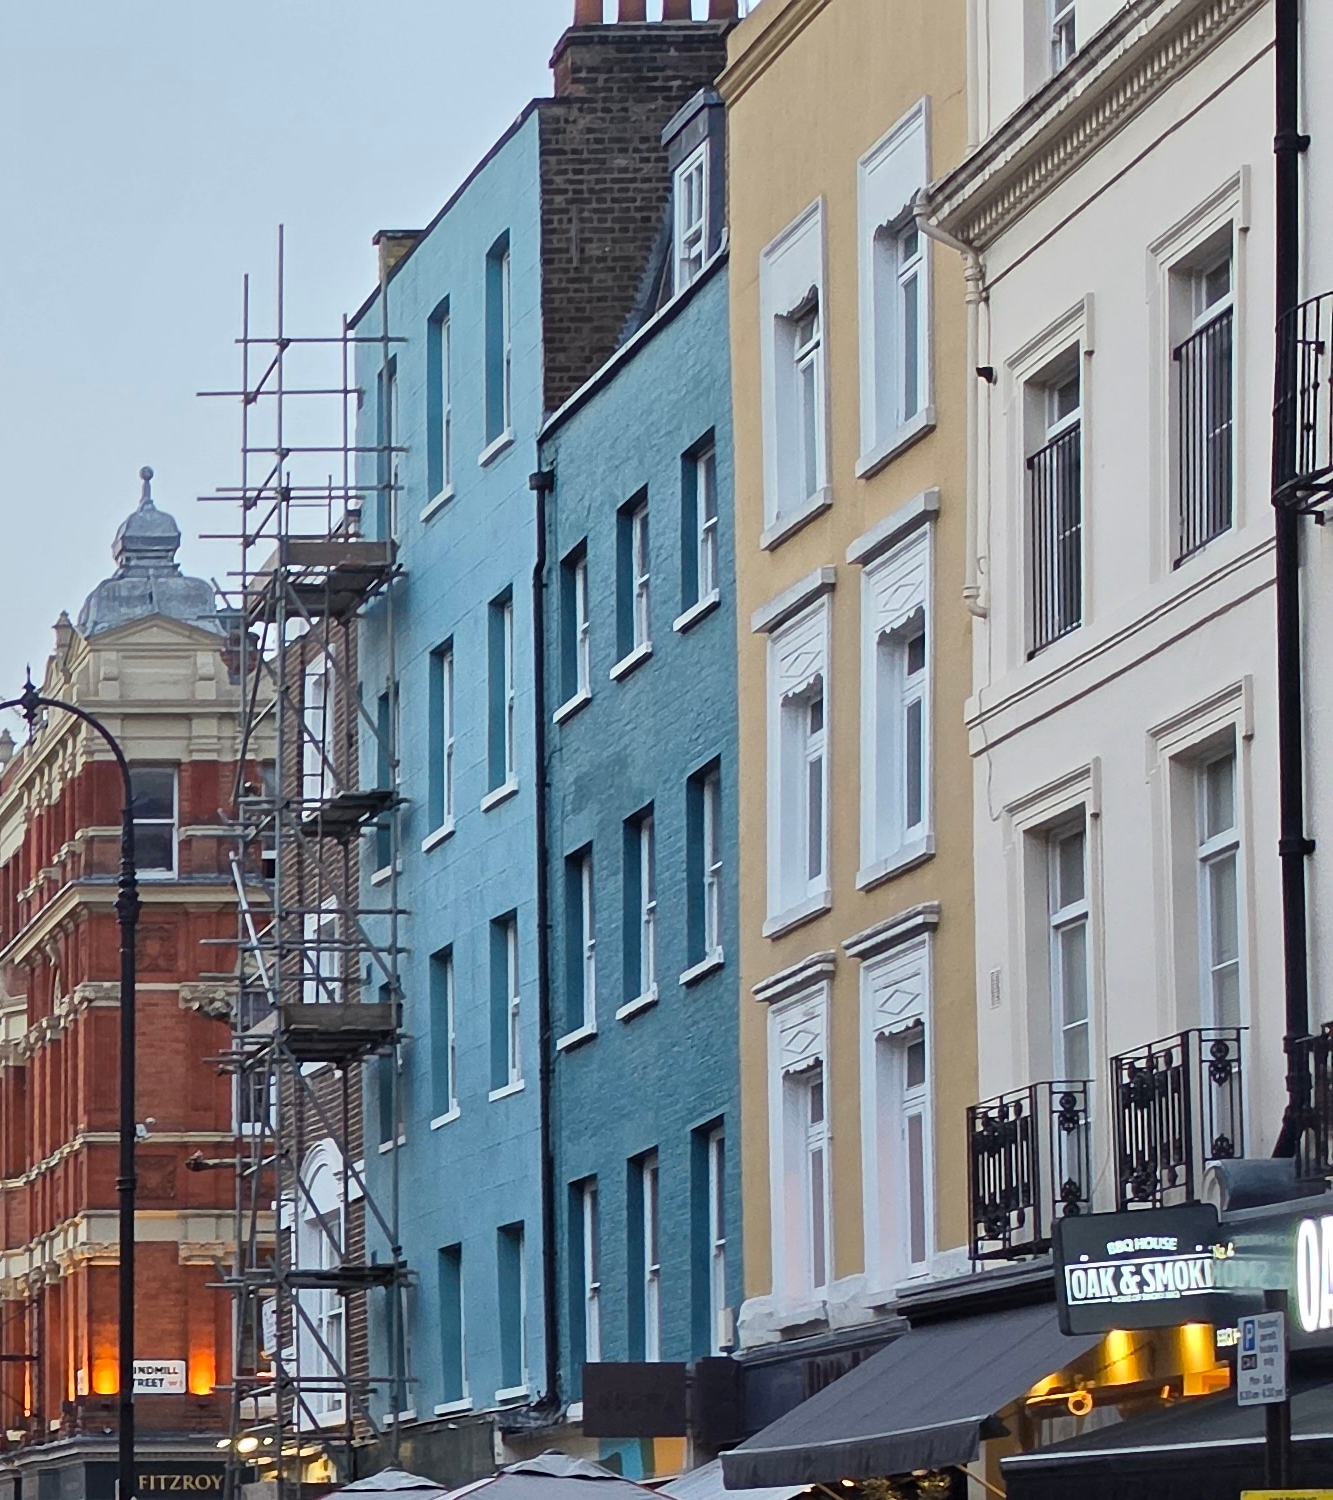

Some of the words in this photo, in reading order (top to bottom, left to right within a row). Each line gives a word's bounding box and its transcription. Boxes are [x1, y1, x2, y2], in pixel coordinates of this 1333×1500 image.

[1134, 1236, 1178, 1251] HOUSE
[1071, 1266, 1117, 1299] OAK
[1119, 1265, 1141, 1295] &
[133, 1366, 179, 1375] INDMILL
[133, 1378, 165, 1388] REET
[138, 1474, 223, 1490] FITZROY
